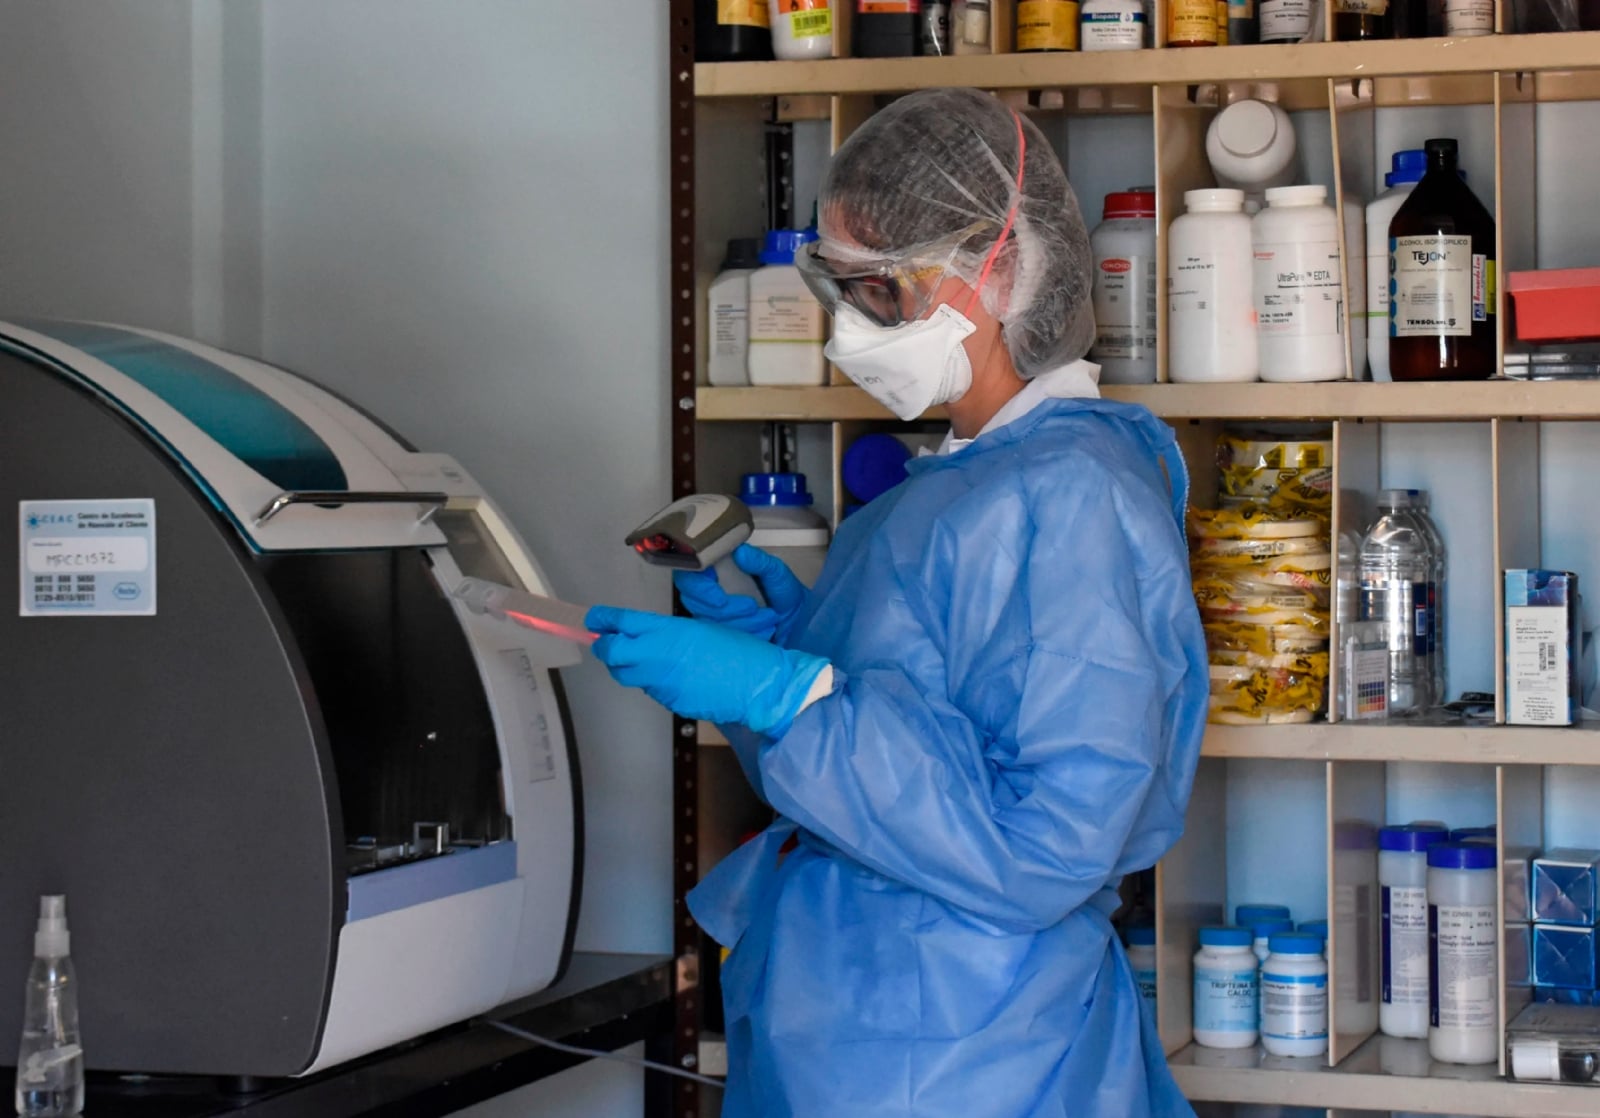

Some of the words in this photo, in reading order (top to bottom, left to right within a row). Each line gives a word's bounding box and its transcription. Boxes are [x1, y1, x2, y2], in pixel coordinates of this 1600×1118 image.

[1092, 12, 1120, 20] Biopack
[1399, 239, 1423, 247] ALCOHOL
[1424, 238, 1469, 246] ISOPOPILICO
[1412, 251, 1447, 265] TEJON
[1102, 262, 1131, 270] OXOID
[1314, 270, 1331, 281] EDTA
